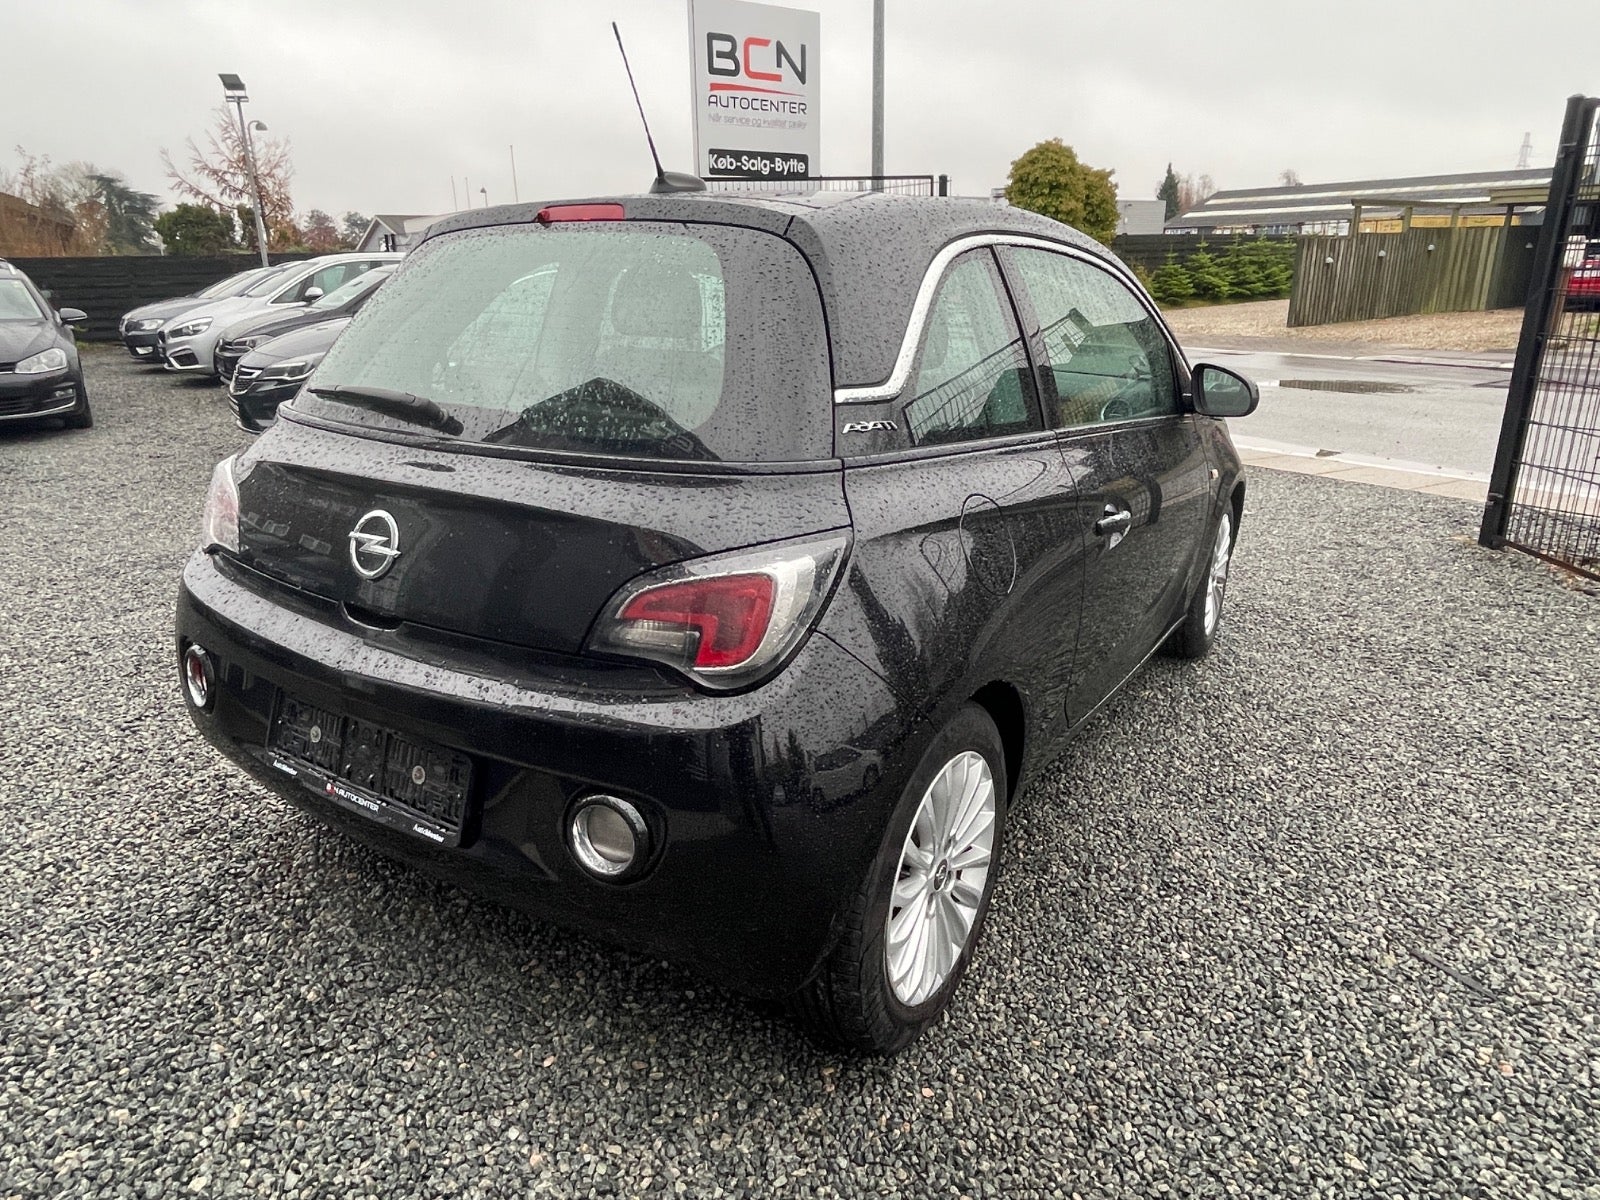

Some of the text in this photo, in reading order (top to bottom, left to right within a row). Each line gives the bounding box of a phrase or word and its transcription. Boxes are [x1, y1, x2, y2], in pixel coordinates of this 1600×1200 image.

[707, 32, 806, 85] BCN
[708, 94, 807, 115] AUTOCENTER
[709, 154, 806, 175] Køb-Salg-Bytte
